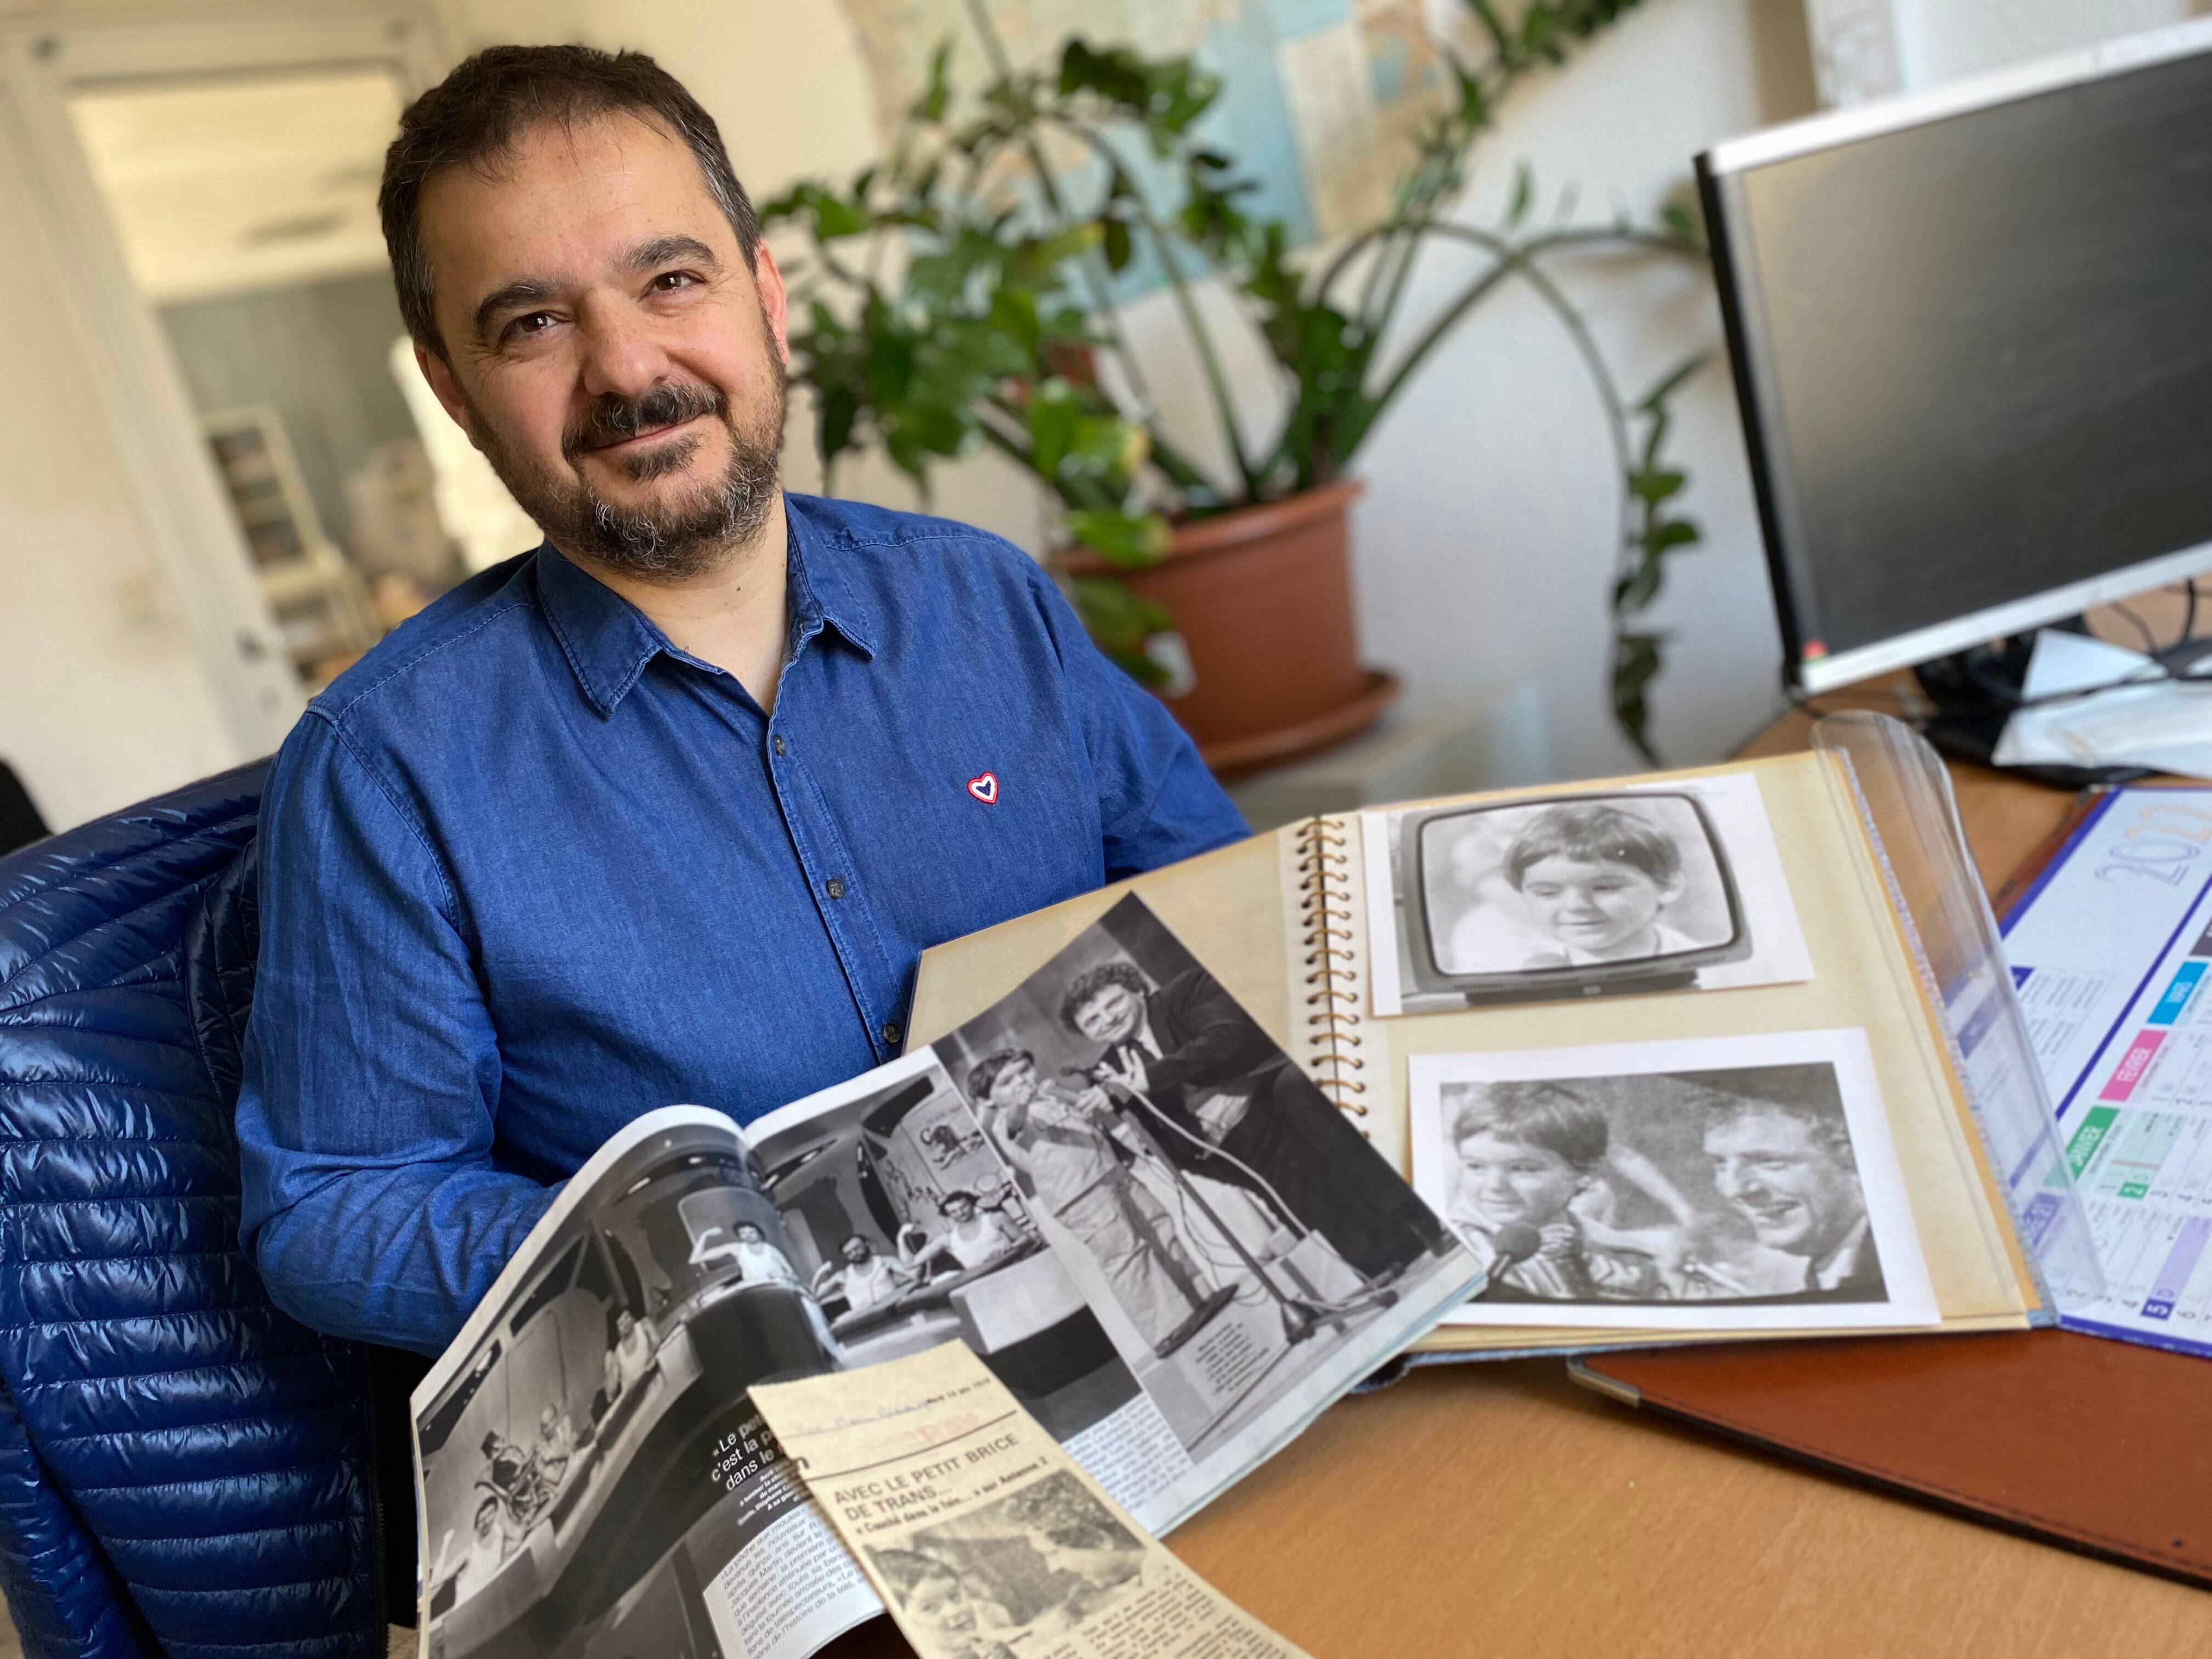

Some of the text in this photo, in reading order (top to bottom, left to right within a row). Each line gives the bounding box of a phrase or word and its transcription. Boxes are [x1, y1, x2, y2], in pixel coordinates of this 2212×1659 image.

[2146, 1302, 2169, 1316] 5
[712, 1447, 743, 1481] c'est
[743, 1438, 759, 1454] la
[726, 1459, 758, 1491] dans
[759, 1448, 775, 1465] le
[833, 1432, 1020, 1505] AVEC LE PETIT BRICE
[844, 1505, 872, 1521] DE
